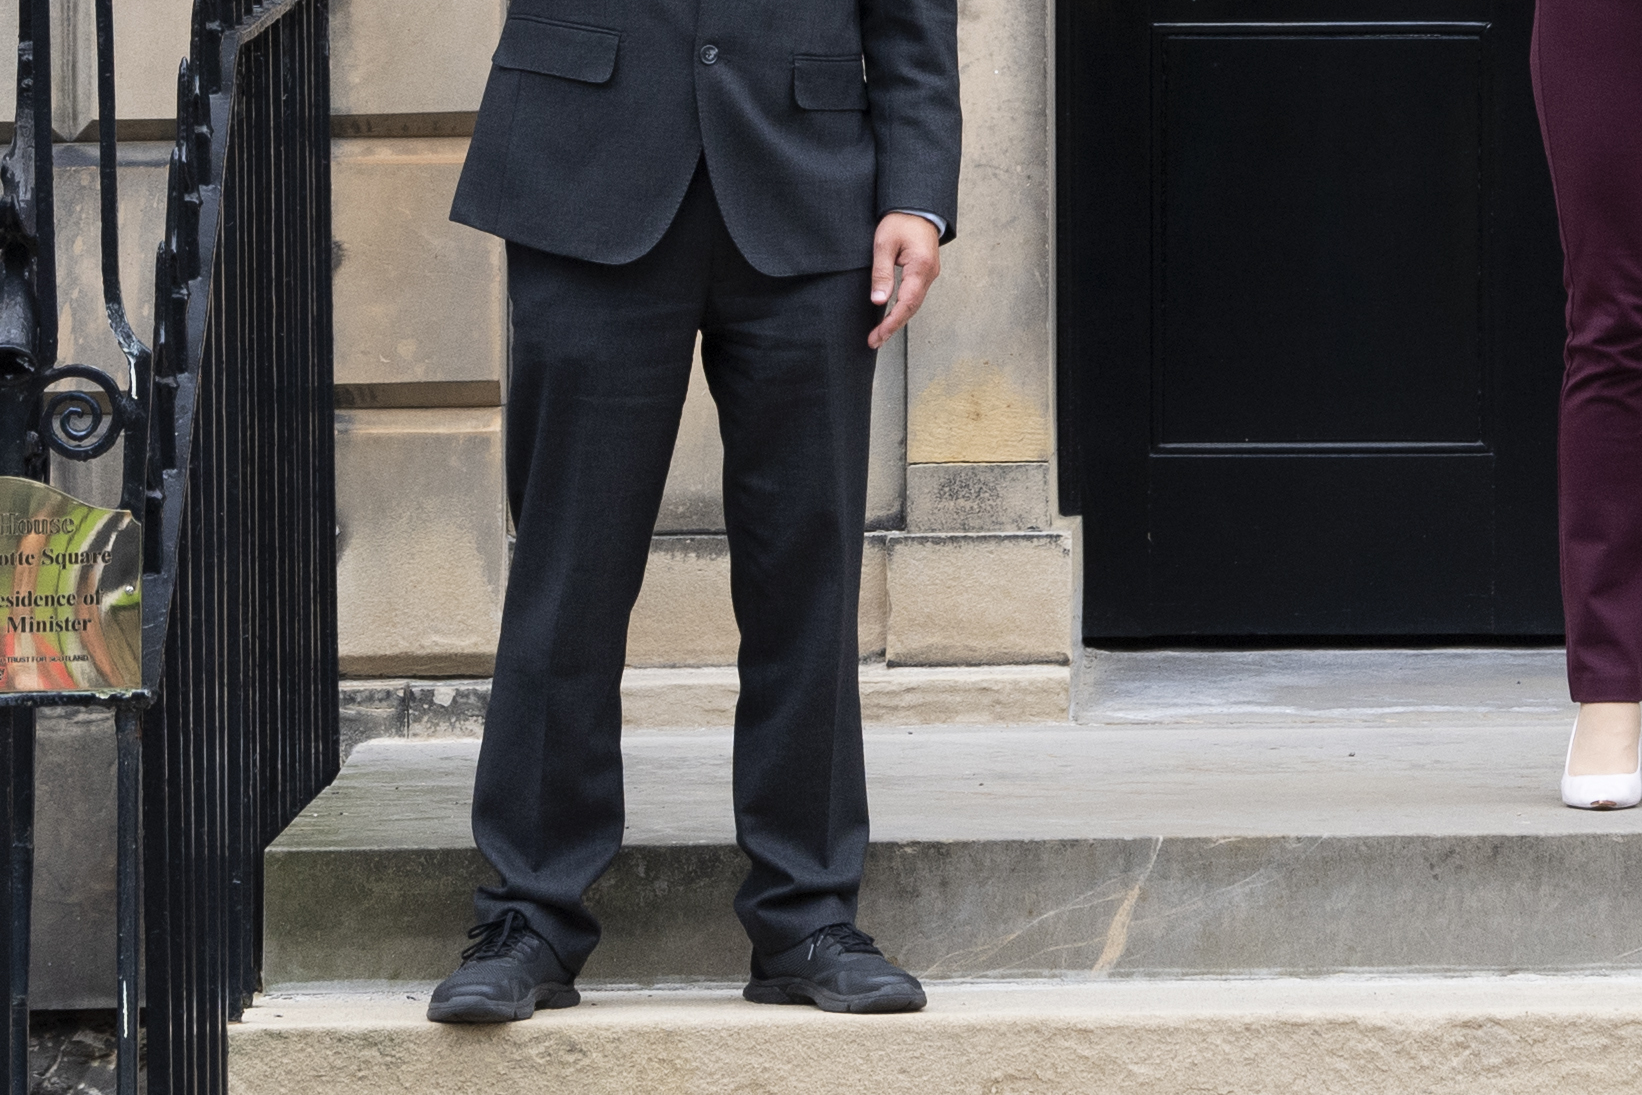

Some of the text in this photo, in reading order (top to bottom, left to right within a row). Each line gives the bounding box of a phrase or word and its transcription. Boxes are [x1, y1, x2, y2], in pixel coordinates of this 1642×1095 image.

[41, 548, 112, 570] Square
[83, 587, 103, 606] of
[7, 616, 92, 633] Minister
